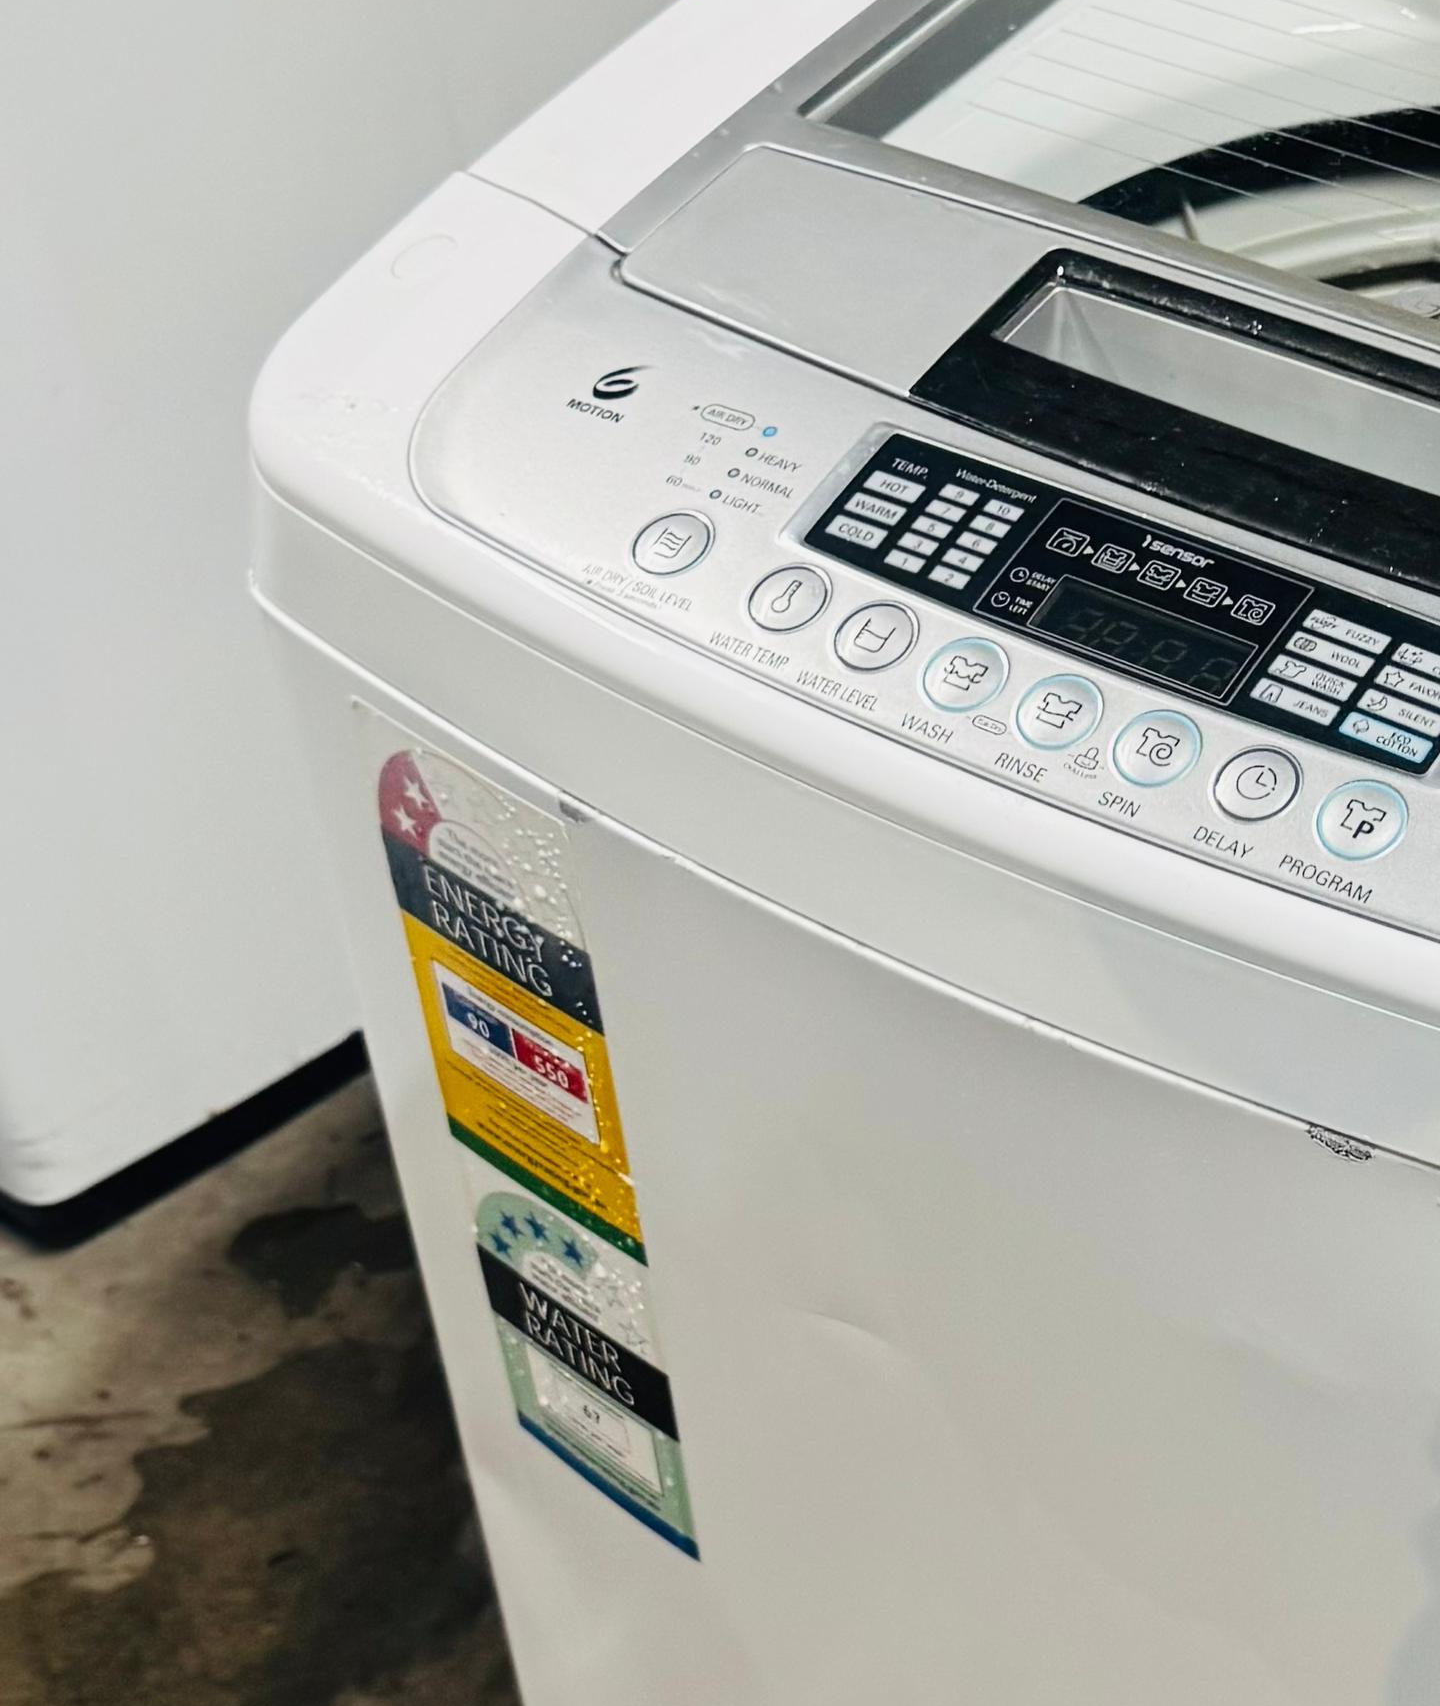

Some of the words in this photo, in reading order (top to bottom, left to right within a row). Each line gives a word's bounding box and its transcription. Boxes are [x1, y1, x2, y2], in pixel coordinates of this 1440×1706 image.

[566, 398, 625, 424] MOTION
[707, 409, 727, 420] AIR
[724, 414, 748, 426] DRY
[700, 432, 721, 446] 120
[757, 451, 802, 473] HEAVY
[666, 475, 683, 487] 60
[741, 472, 795, 500] NORMAL
[880, 479, 908, 495] HOT
[722, 494, 762, 514] LIGHT
[854, 498, 899, 520] WARM
[999, 505, 1010, 516] 10
[838, 522, 874, 543] COLD
[958, 556, 966, 565] 4
[943, 573, 953, 582] 2
[632, 581, 658, 599] SOIL
[659, 591, 693, 612] LEVEL
[709, 631, 754, 660] WATER
[1345, 628, 1381, 646] FUZZY
[1331, 651, 1361, 669] WOOL
[796, 670, 841, 697] WATER
[839, 687, 880, 713] LEVEL
[1311, 680, 1342, 696] WASH
[1293, 700, 1329, 718] JEANS
[1398, 709, 1436, 728] SILENT
[901, 713, 954, 744] WASH
[1391, 732, 1412, 744] ECO
[1376, 736, 1418, 757] COTTON
[994, 752, 1048, 783] RINSE
[1098, 791, 1141, 818] SPIN
[1193, 825, 1254, 859] DELAY
[1279, 854, 1373, 904] PROGRAM
[424, 864, 545, 964] ENERGY
[432, 900, 553, 997] RATING
[466, 1012, 490, 1039] 90
[533, 1055, 570, 1090] 550
[519, 1282, 621, 1373] WATER
[526, 1310, 634, 1406] RATING
